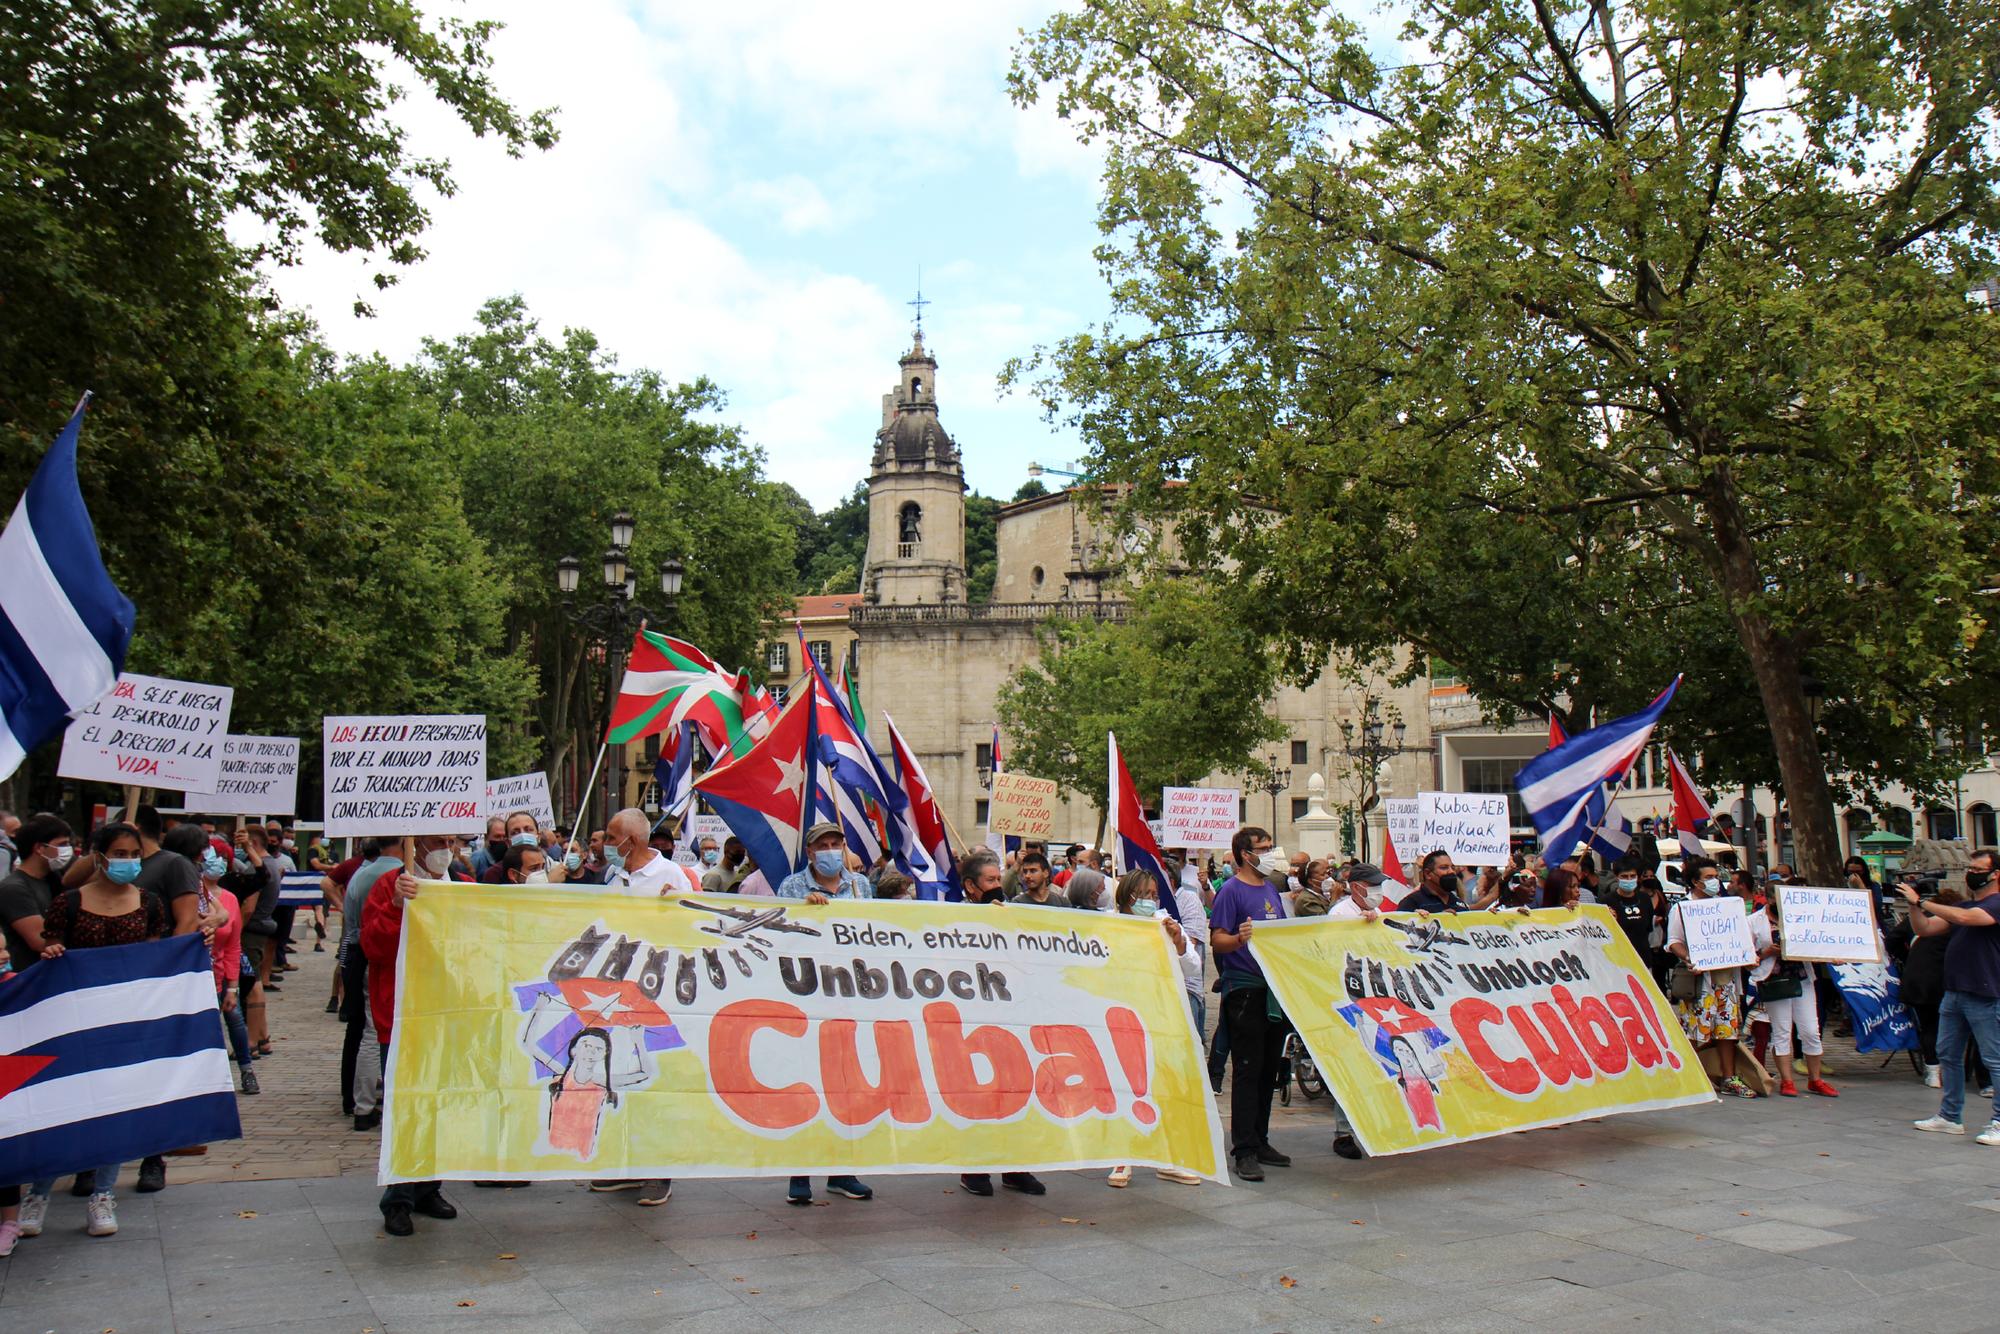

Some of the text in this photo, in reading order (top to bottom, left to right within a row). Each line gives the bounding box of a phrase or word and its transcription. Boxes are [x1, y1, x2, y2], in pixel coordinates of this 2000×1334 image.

[178, 691, 222, 712] NIEGA
[112, 704, 199, 732] DESARROLLO
[207, 718, 219, 735] Y
[82, 726, 214, 759] EL DERECHO A LA
[330, 725, 358, 743] LOS
[408, 724, 487, 742] PERSIGUEN
[256, 742, 296, 757] PUEBLO
[330, 749, 480, 768] POR EL MUNDO TODAS
[331, 775, 473, 793] LAS TRANSACCIONES
[997, 775, 1055, 795] EL RESPETO
[994, 791, 1043, 808] AL DERECHO
[1434, 796, 1505, 816] Kuba-AEB
[332, 801, 421, 819] COMERCIALES
[421, 801, 441, 819] DE
[1017, 808, 1050, 821] AJENO
[995, 818, 1011, 831] ES
[1015, 821, 1027, 833] LA
[1784, 911, 1815, 924] ezin
[832, 923, 1110, 958] Biden, entzun mundua:
[1469, 929, 1520, 951] Biden,
[1729, 937, 1742, 949] du
[779, 957, 1012, 1002] Unblock
[1458, 949, 1590, 993] Unblock
[1450, 974, 1682, 1095] Cuba!
[708, 999, 1157, 1131] Cuba!
